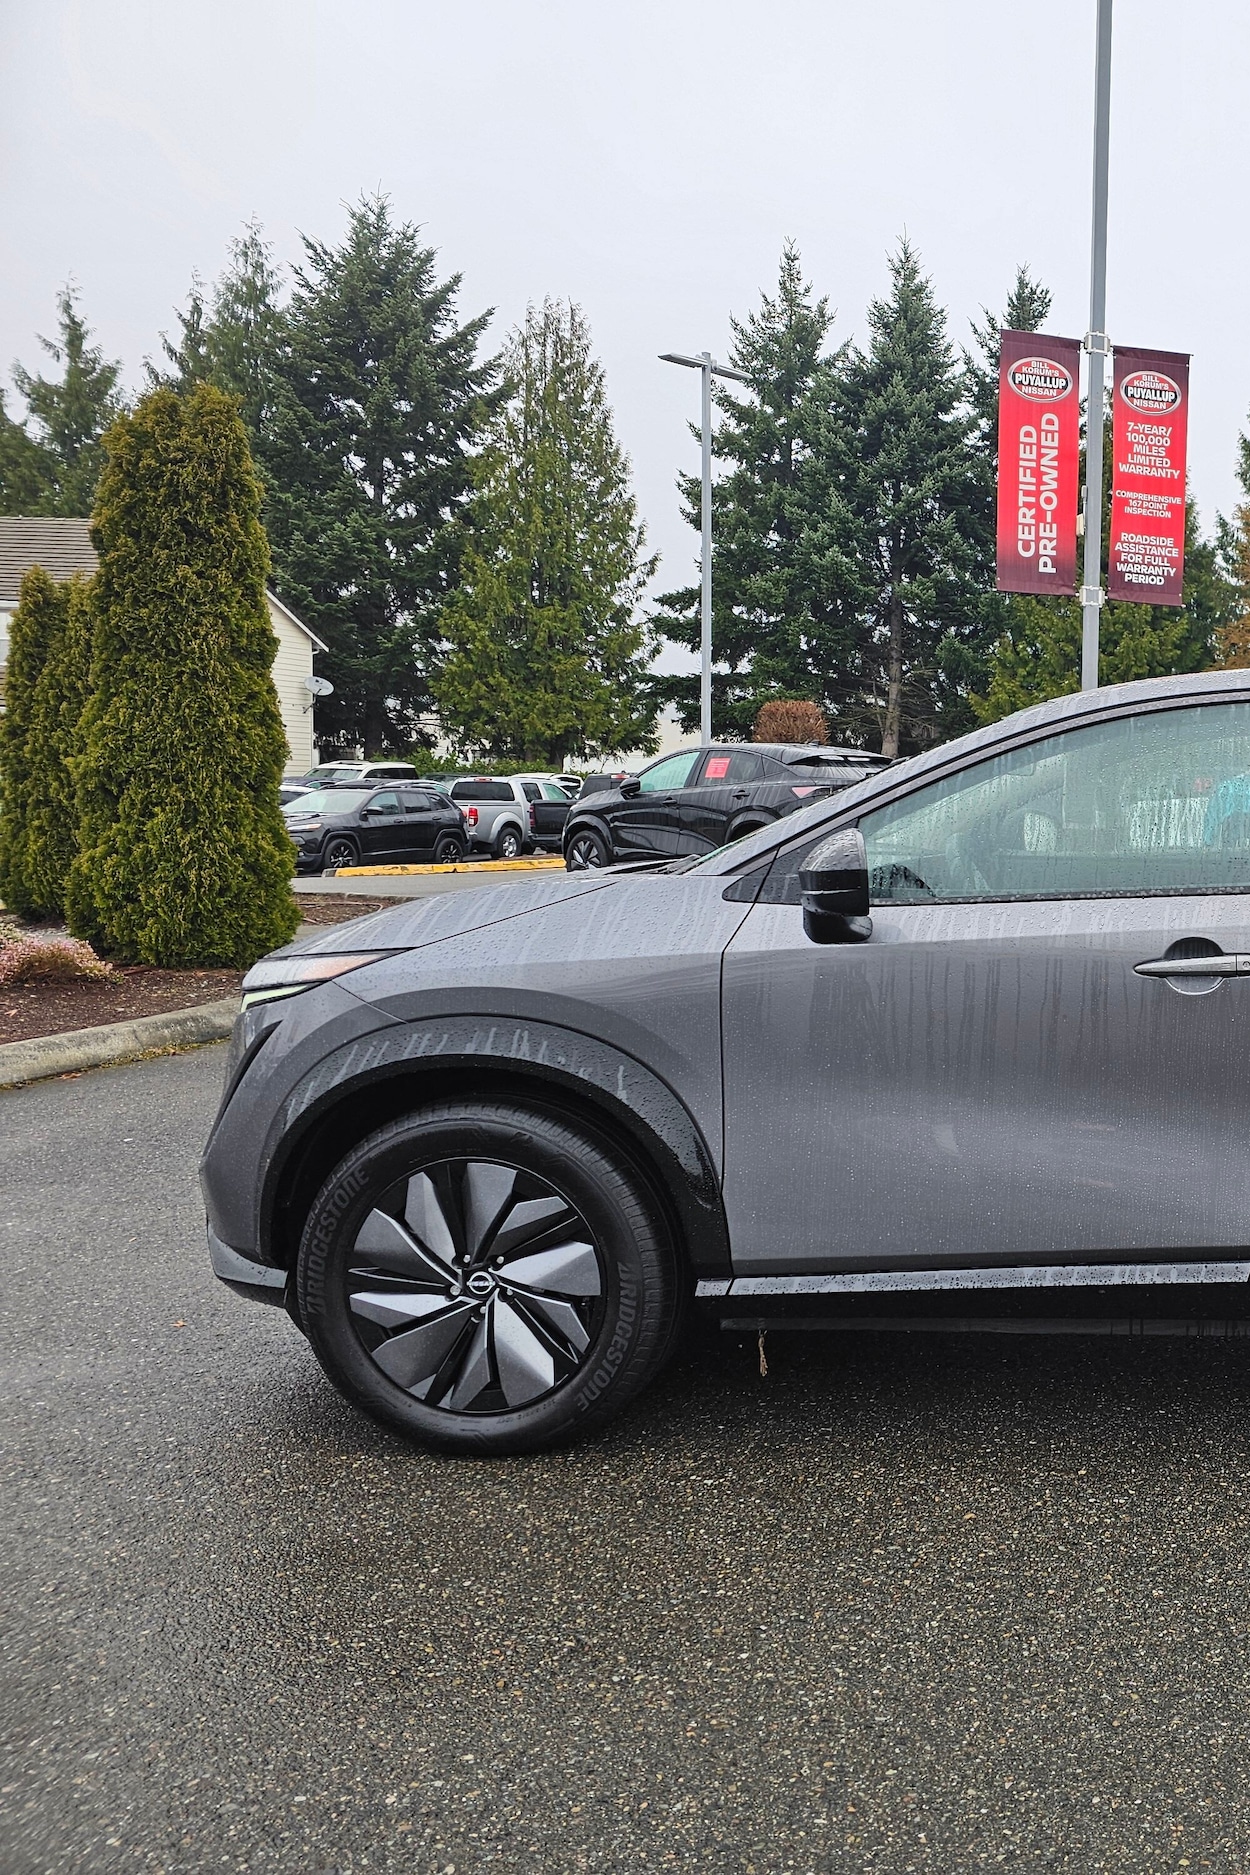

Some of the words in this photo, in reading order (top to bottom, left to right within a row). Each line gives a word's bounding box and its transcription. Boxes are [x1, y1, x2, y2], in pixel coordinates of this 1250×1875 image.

[1022, 366, 1059, 377] KORUM'S
[1031, 361, 1050, 369] BILL
[1015, 373, 1067, 389] PUYALLUP
[1133, 380, 1169, 390] KORUM'S
[1142, 374, 1159, 383] BILL
[1022, 386, 1057, 397] NISSAN
[1128, 386, 1176, 402] PUYALLUP
[1133, 399, 1167, 410] NISSAN
[1127, 422, 1172, 437] 7-YEAR/
[1126, 433, 1171, 446] 100,000
[1133, 444, 1166, 456] MILES
[1128, 453, 1171, 467] LIMITED
[1119, 462, 1181, 479] WARRANTY
[1018, 425, 1037, 558] CERTIFIED
[1038, 412, 1060, 574] PRE-OWNED
[1115, 490, 1182, 504] COMPREHENSIVE
[1124, 506, 1171, 518] INSPECTION
[1129, 499, 1142, 507] 167
[1143, 501, 1168, 511] POINT
[1121, 532, 1174, 547] ROADSIDE
[1115, 542, 1179, 557] ASSISTANCE
[1121, 553, 1143, 564] FOR
[1144, 556, 1170, 566] FULL
[1116, 562, 1176, 577] WARRANTY
[1124, 573, 1165, 585] PERIOD
[306, 1164, 370, 1316] BRIDGESTONE
[577, 1261, 642, 1412] BRIDGESTONE
